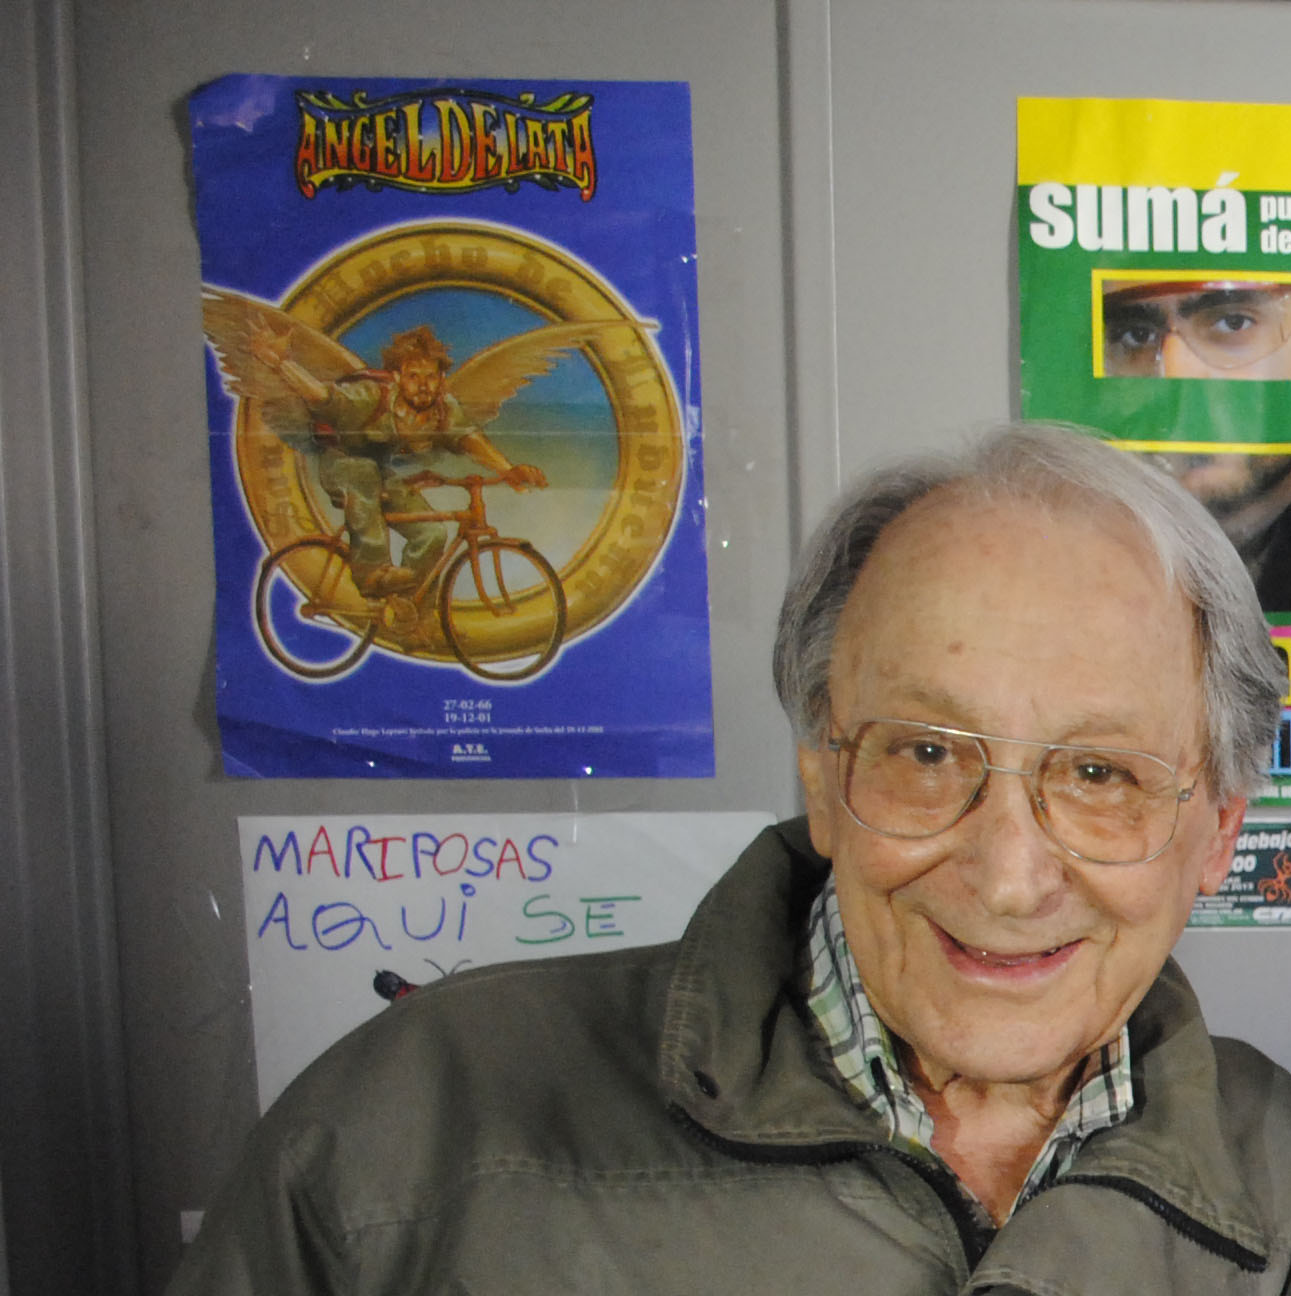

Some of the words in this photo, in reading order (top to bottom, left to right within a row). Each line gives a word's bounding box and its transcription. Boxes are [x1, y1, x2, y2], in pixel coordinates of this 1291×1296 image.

[1028, 172, 1247, 254] sumá
[443, 699, 492, 711] 27-02-66
[445, 711, 491, 723] 19-12-01
[253, 824, 560, 883] MARIPOSAS
[516, 893, 643, 945] SE
